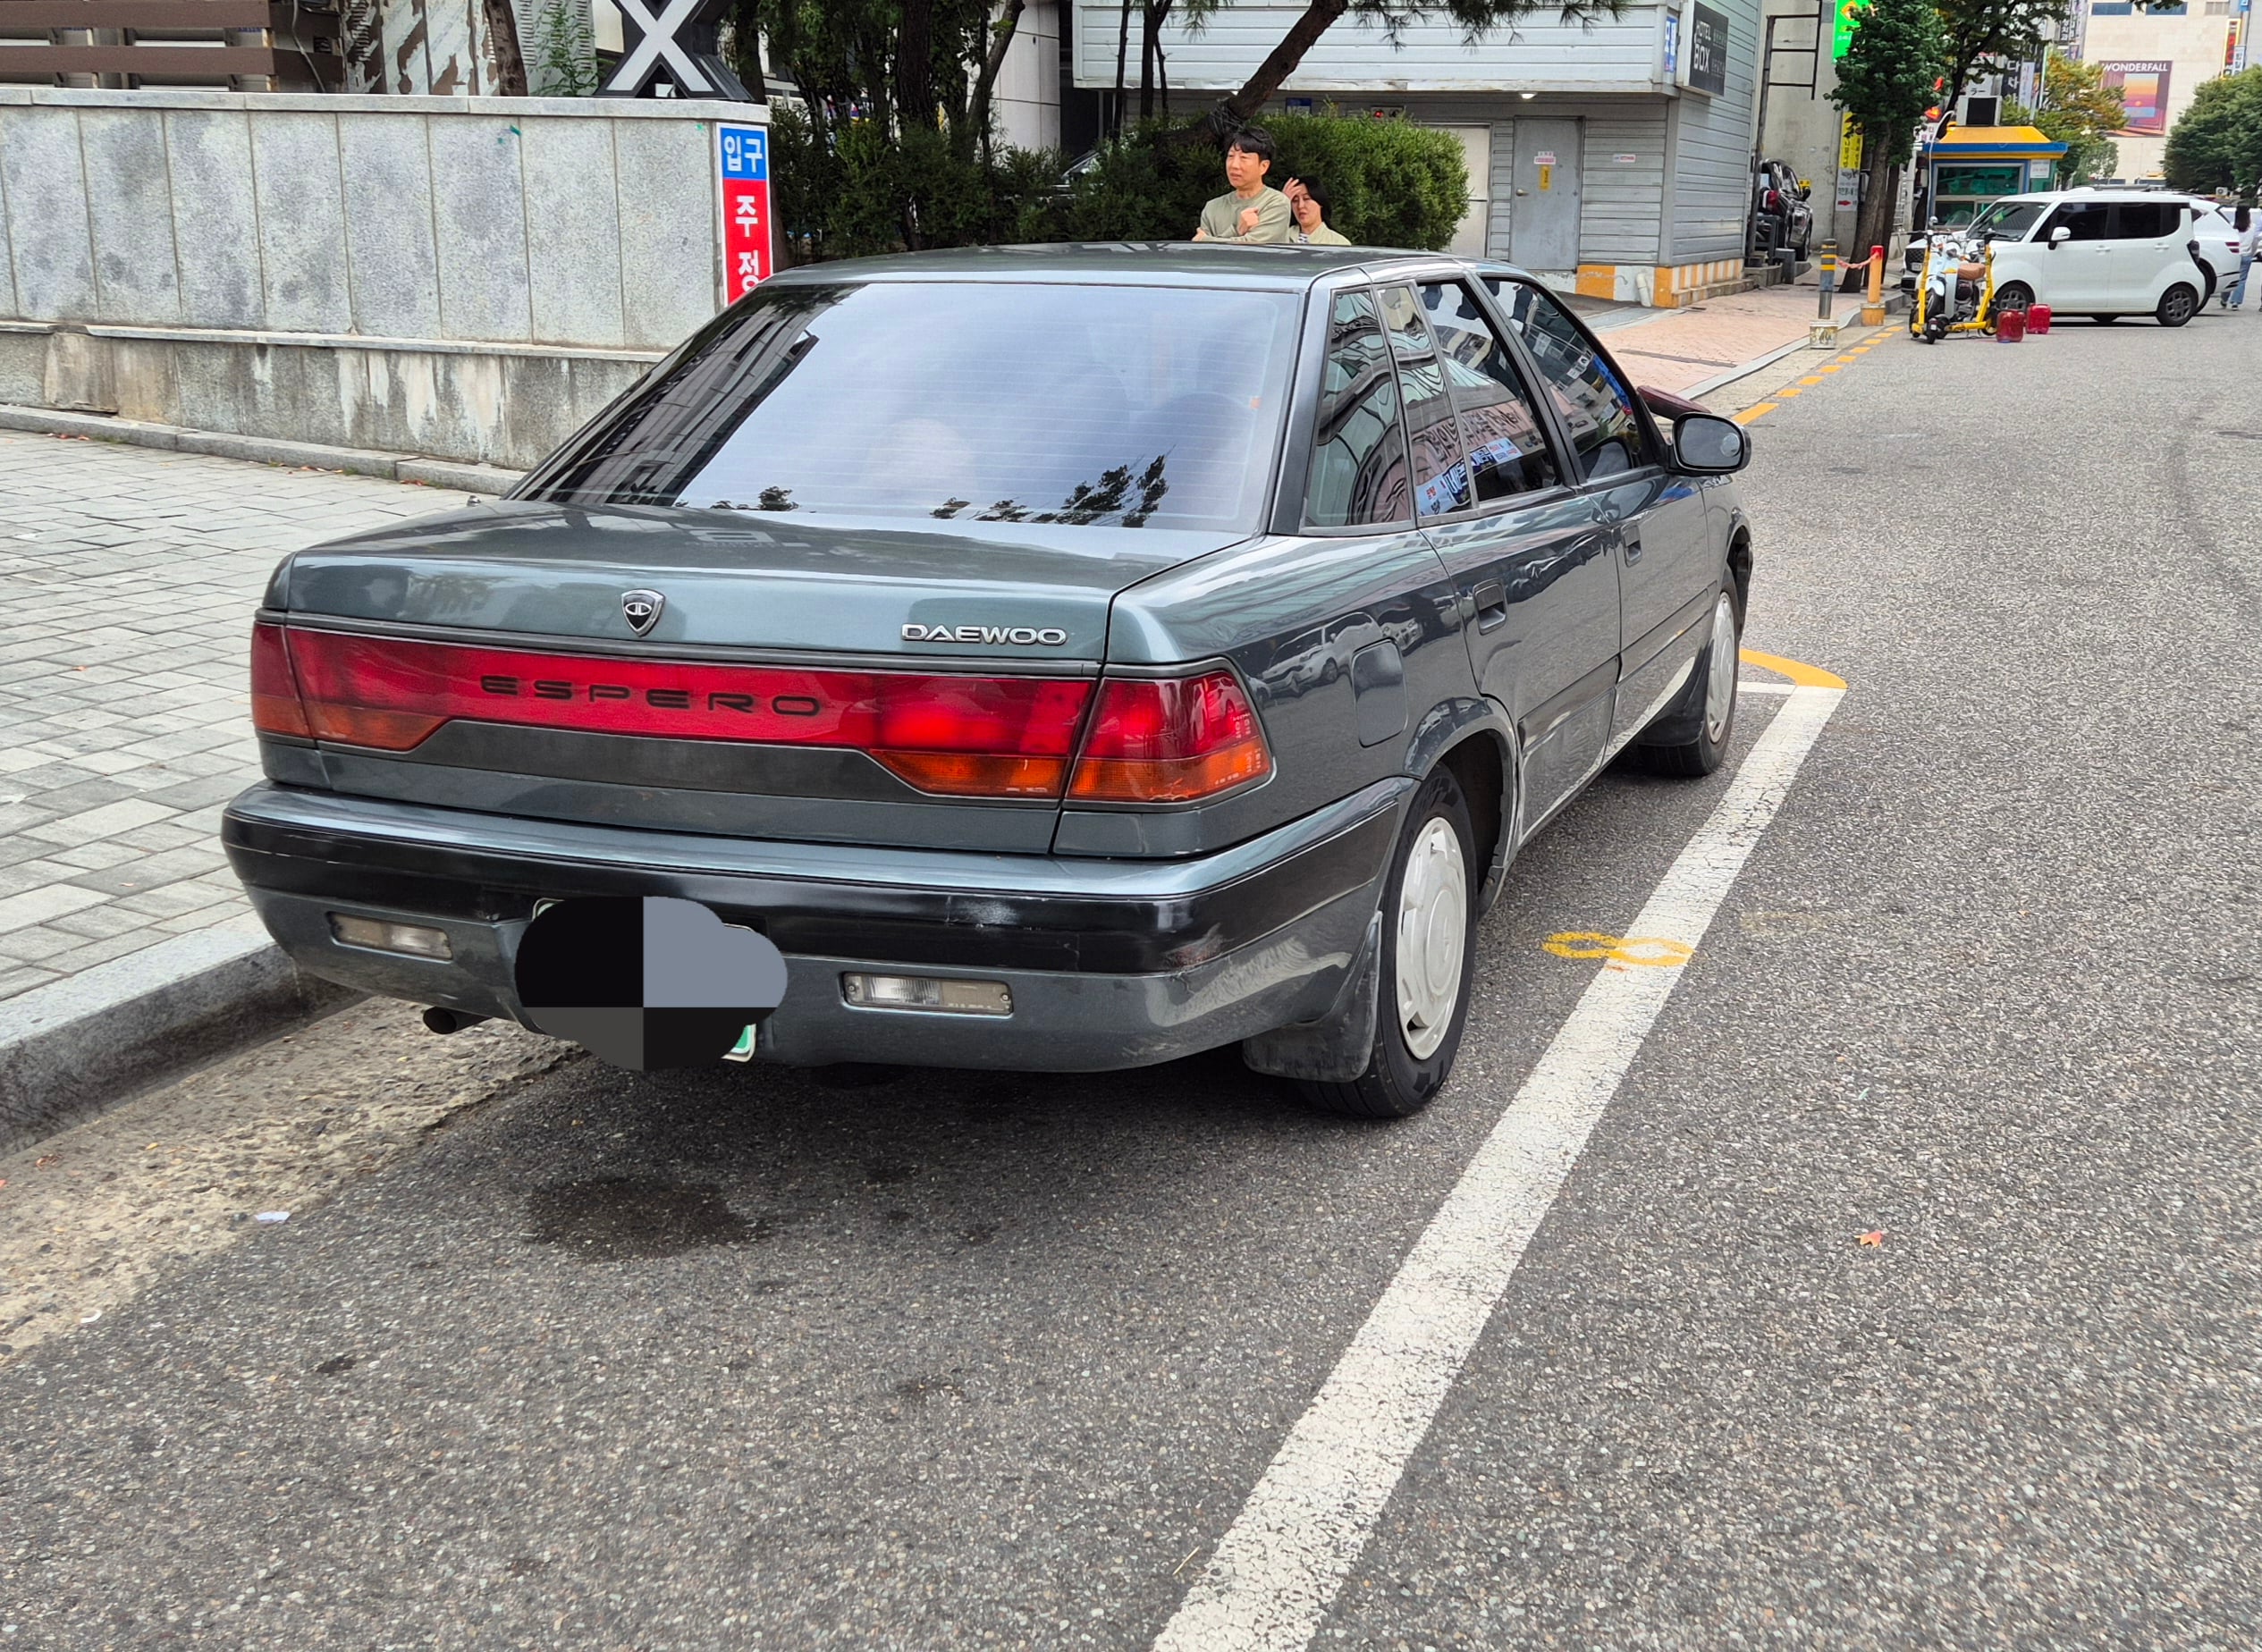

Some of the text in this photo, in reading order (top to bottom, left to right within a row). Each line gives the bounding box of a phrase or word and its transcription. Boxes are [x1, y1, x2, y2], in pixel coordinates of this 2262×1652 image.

[1694, 44, 1710, 73] BOX
[2102, 63, 2168, 72] WONDERFALL
[723, 135, 763, 173] 입구
[735, 195, 760, 292] 주정
[901, 624, 1068, 645] DAEWOO
[480, 675, 821, 716] ESPERO
